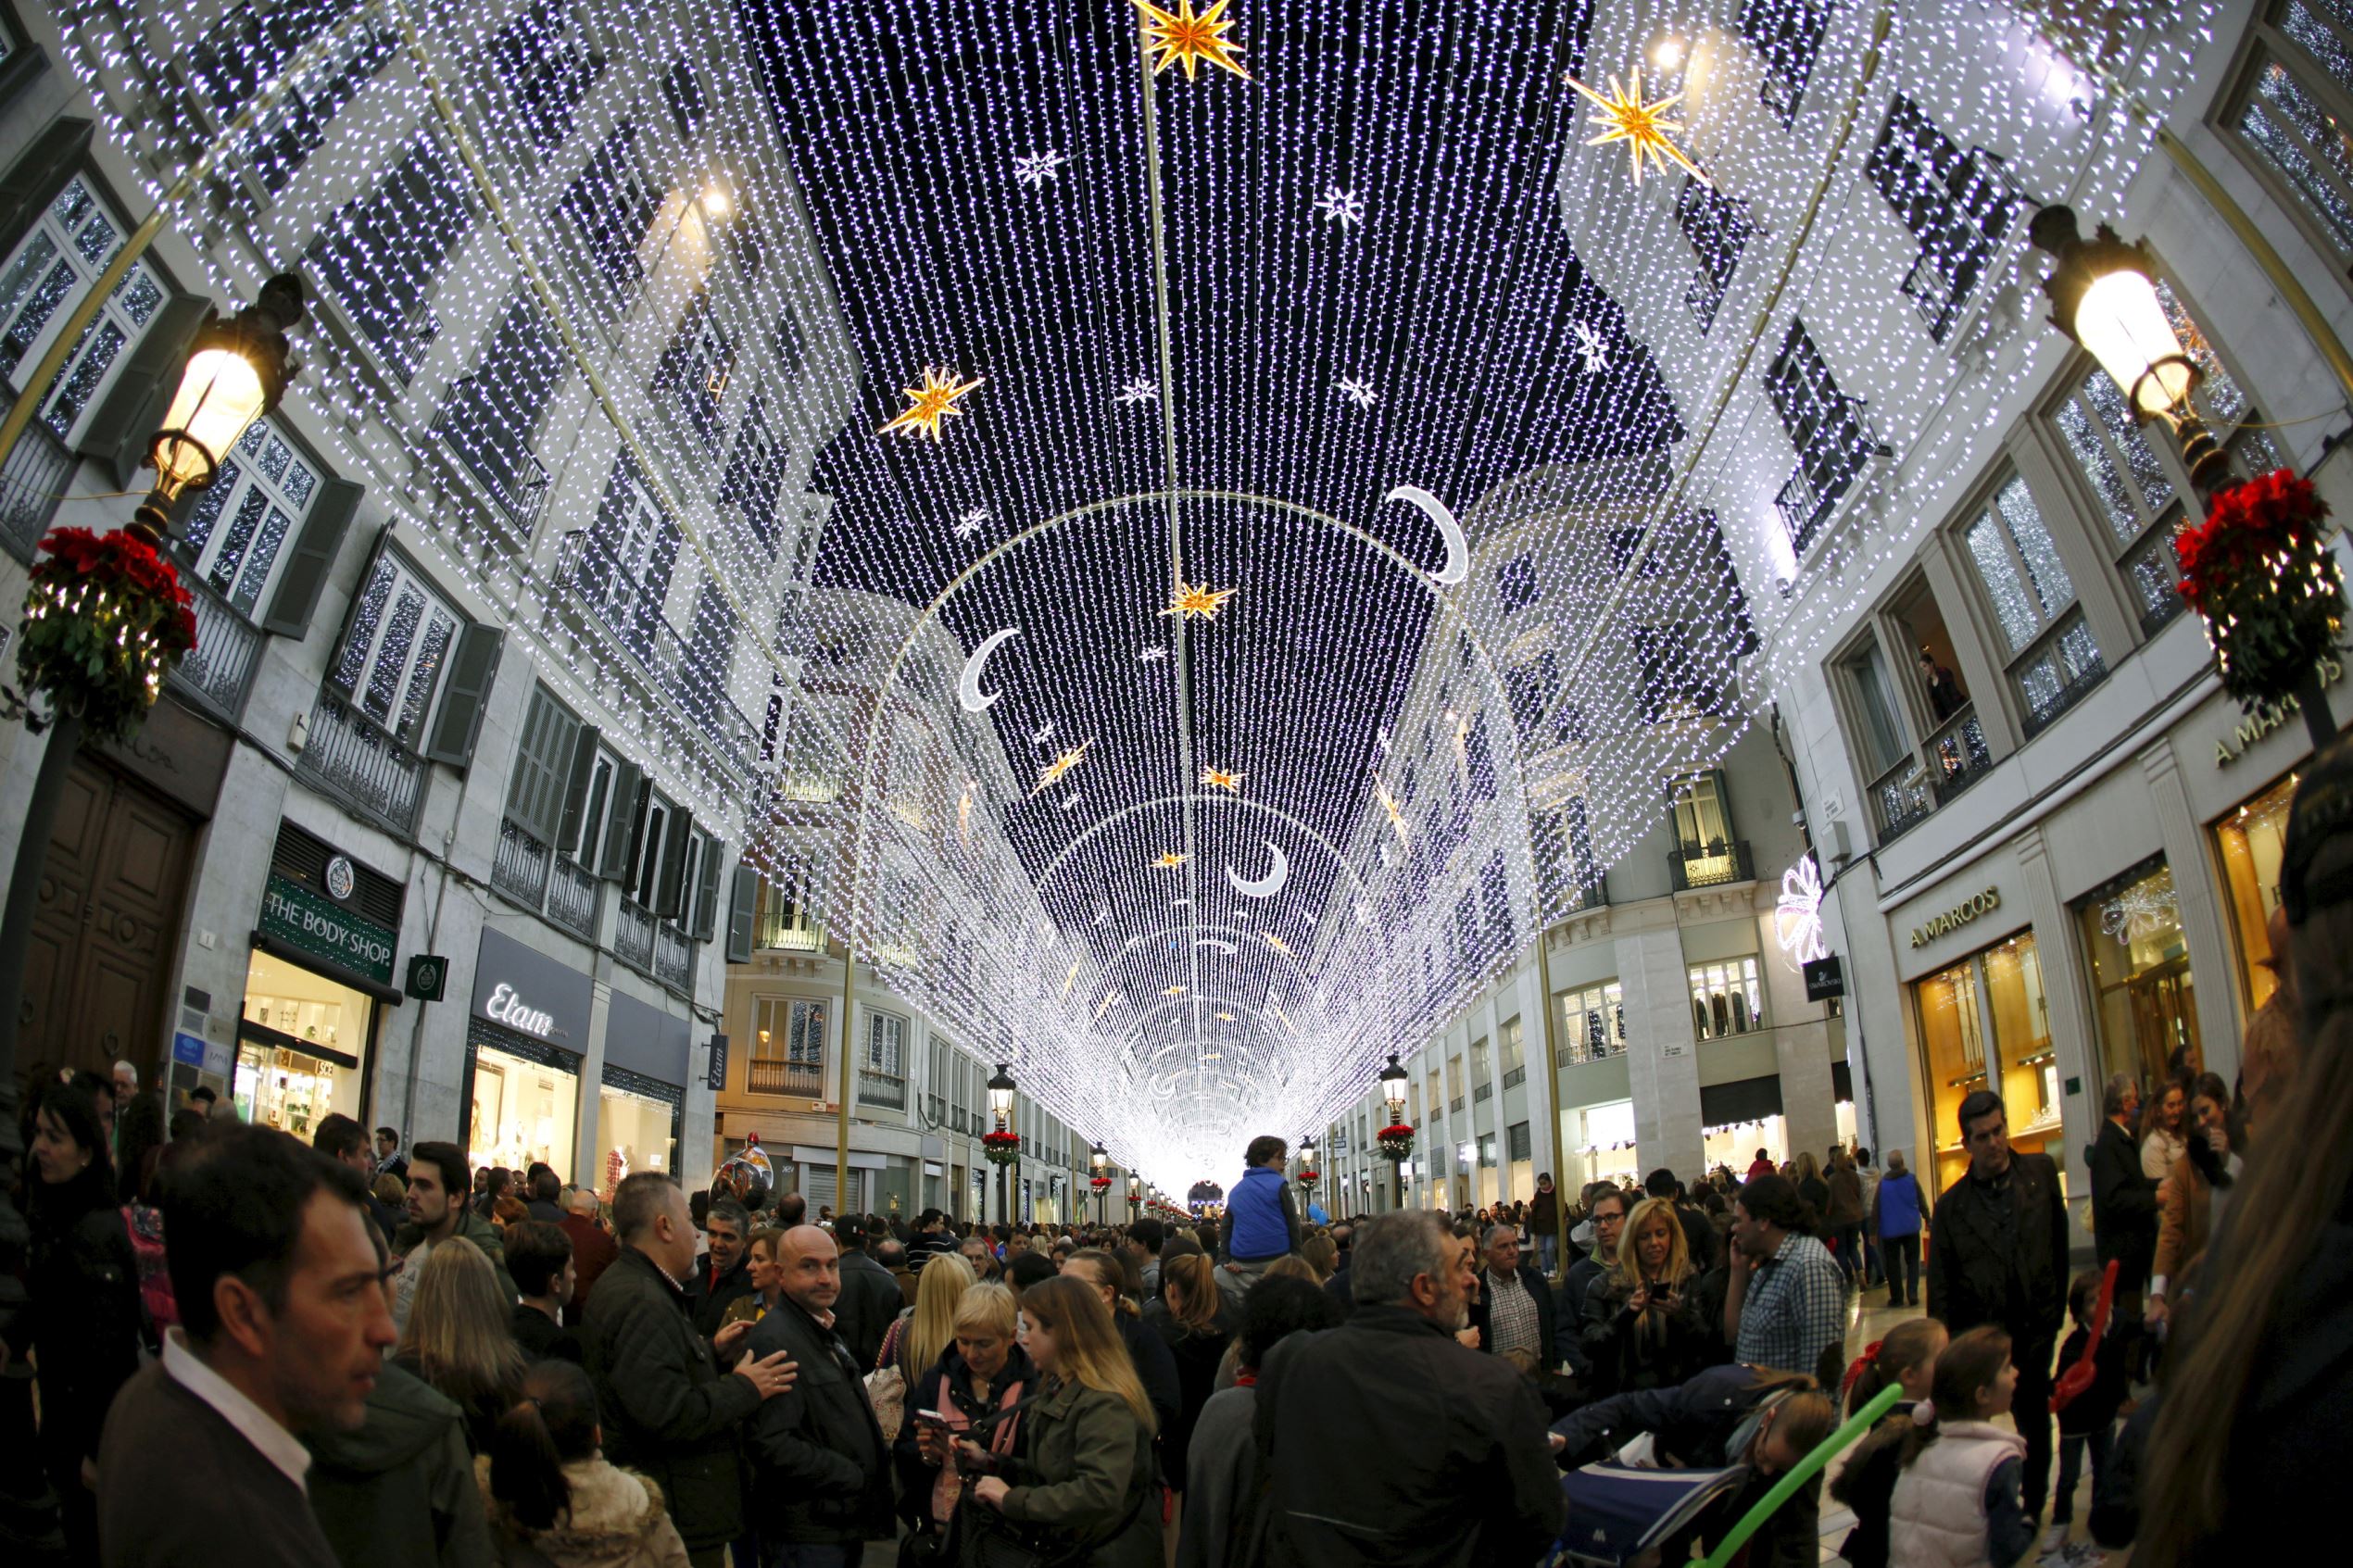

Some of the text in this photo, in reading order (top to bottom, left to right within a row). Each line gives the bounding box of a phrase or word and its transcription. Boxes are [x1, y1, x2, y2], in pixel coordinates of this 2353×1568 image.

[270, 891, 300, 925] THE
[304, 910, 350, 947] BODY
[486, 983, 554, 1036] Etam
[711, 1047, 724, 1086] Etam
